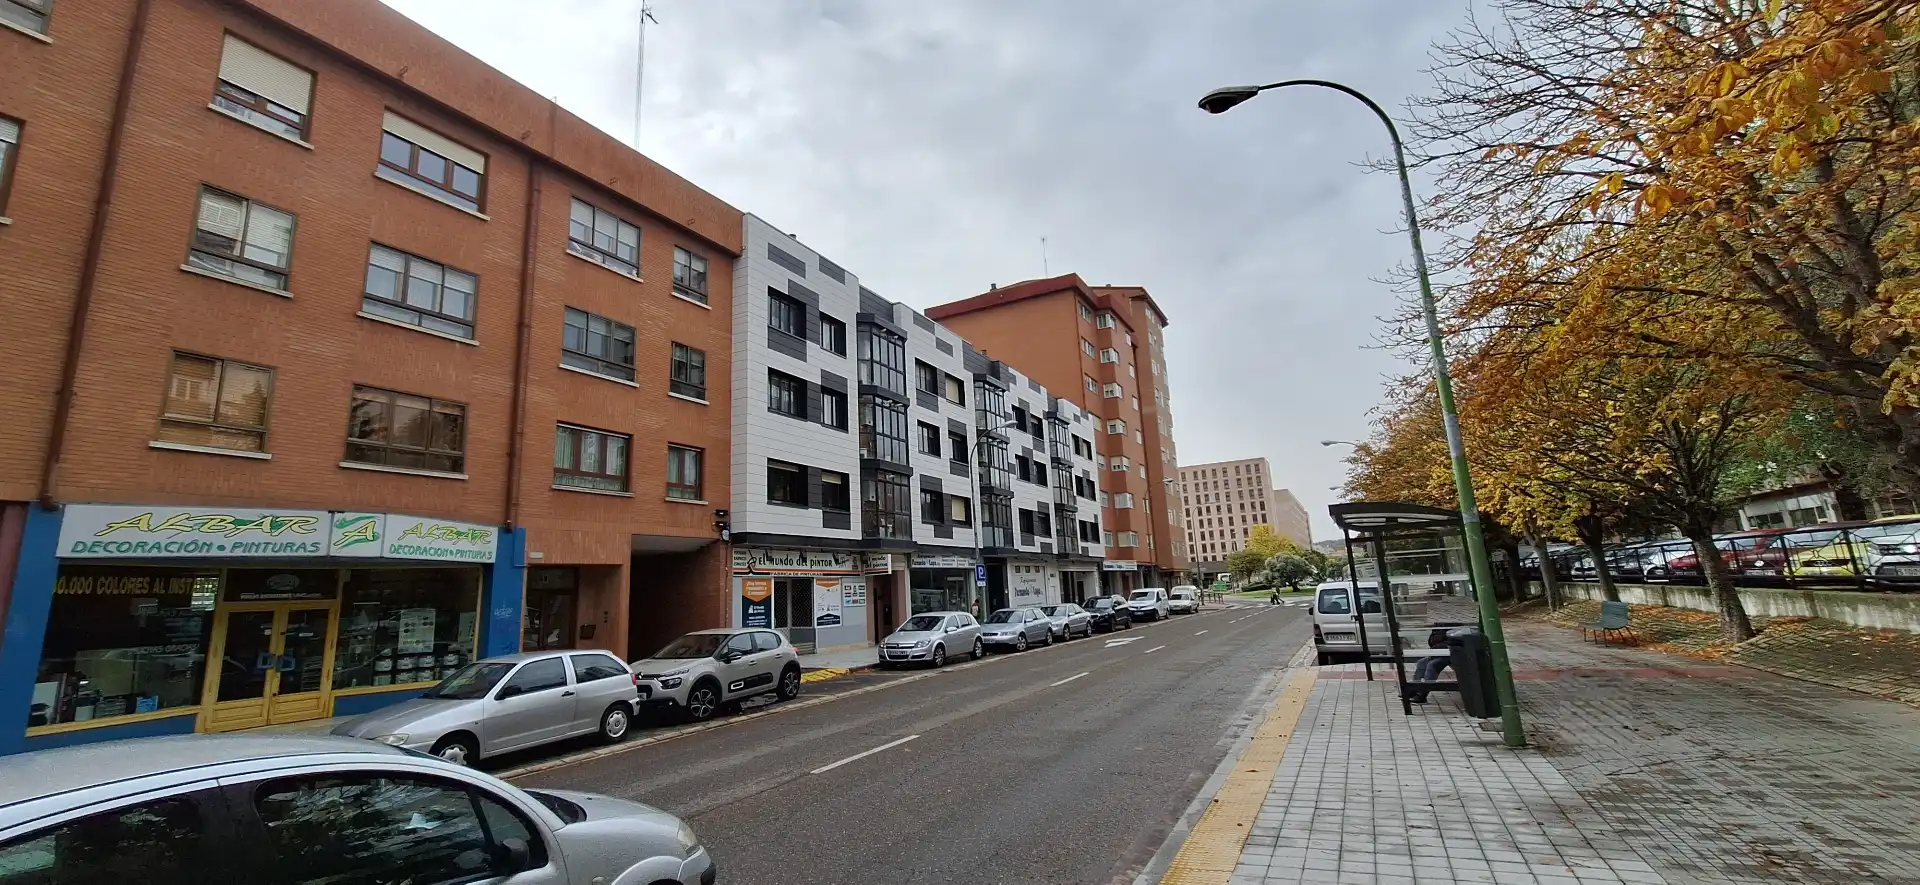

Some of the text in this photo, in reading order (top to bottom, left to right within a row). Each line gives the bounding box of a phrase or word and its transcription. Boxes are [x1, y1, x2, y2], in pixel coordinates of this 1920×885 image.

[94, 512, 319, 539] ALBAR
[398, 522, 492, 545] ALBAR
[71, 539, 321, 554] DECORACIÓN PINTURAS
[454, 549, 493, 560] PINTURAS
[977, 566, 984, 579] P
[96, 575, 151, 595] COLORES
[152, 576, 168, 594] AL
